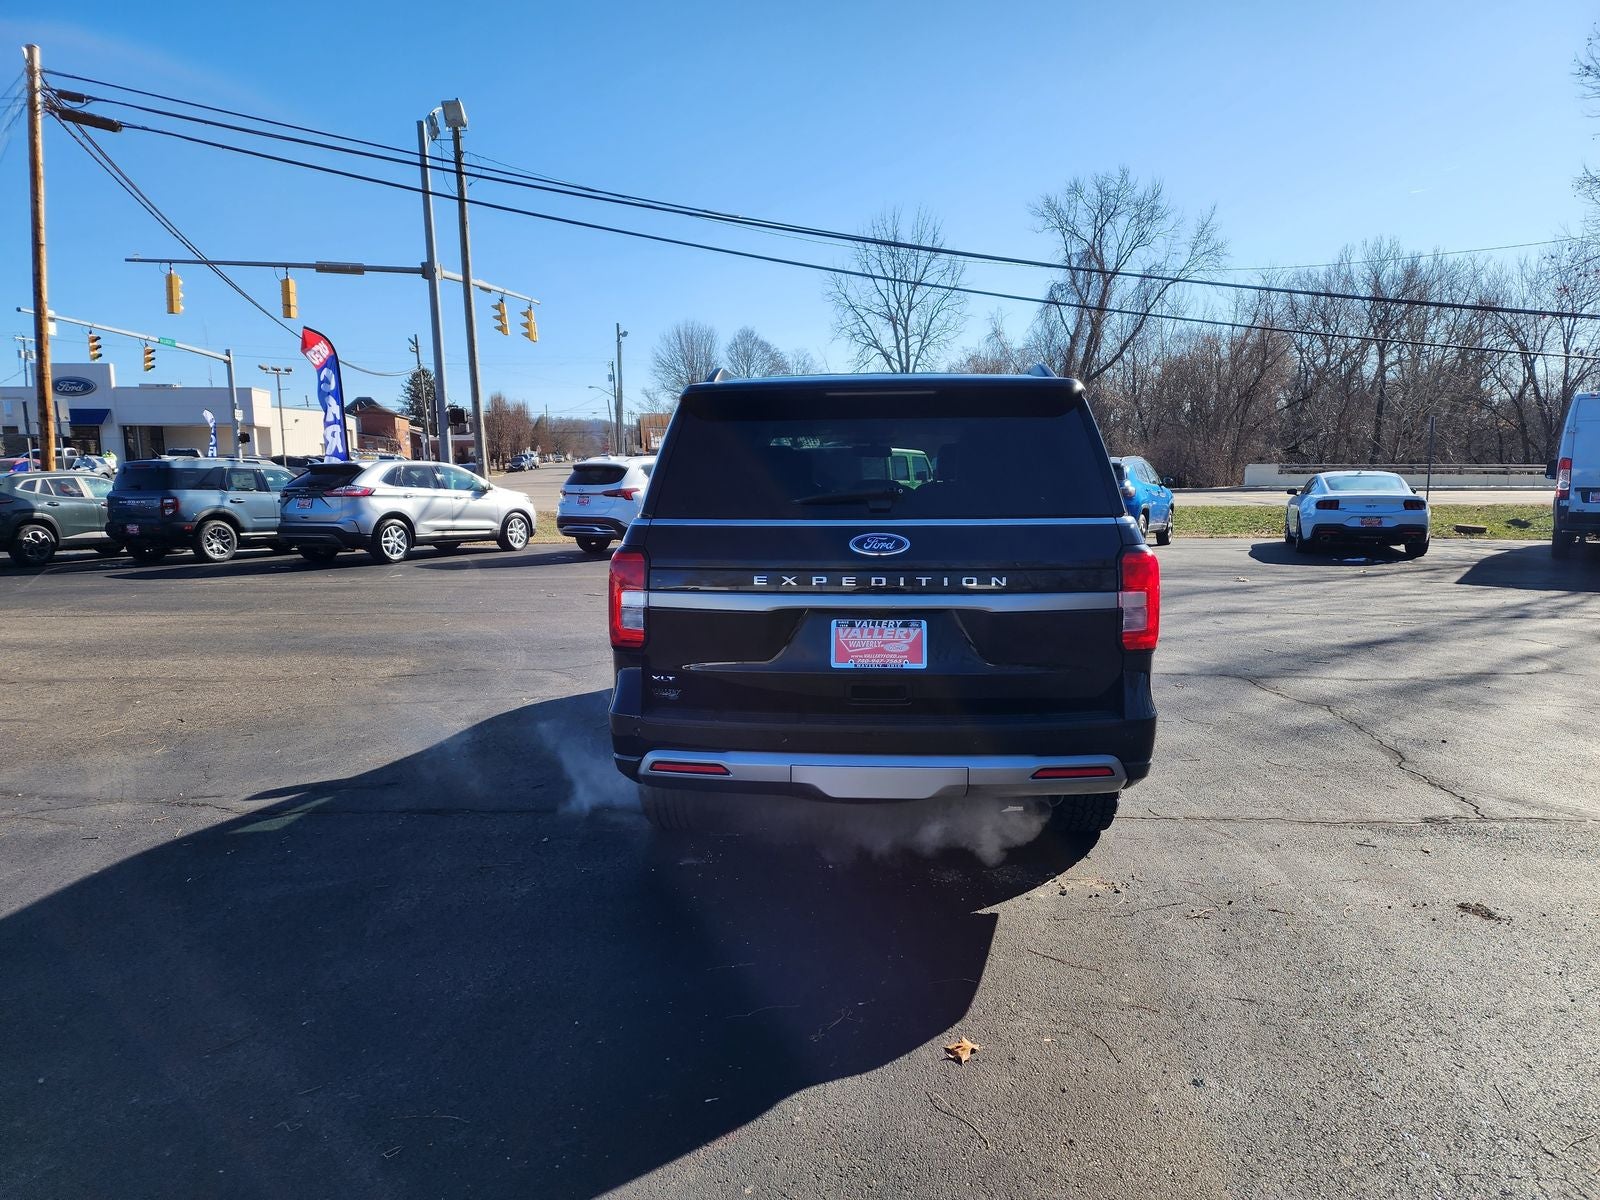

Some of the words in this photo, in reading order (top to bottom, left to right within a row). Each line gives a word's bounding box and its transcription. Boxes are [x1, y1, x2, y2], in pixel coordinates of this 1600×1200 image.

[56, 380, 84, 391] Ford
[863, 536, 896, 550] Ford
[753, 575, 1007, 587] EXPEDITION
[854, 620, 902, 628] VALLERY
[838, 627, 921, 640] VALLERY
